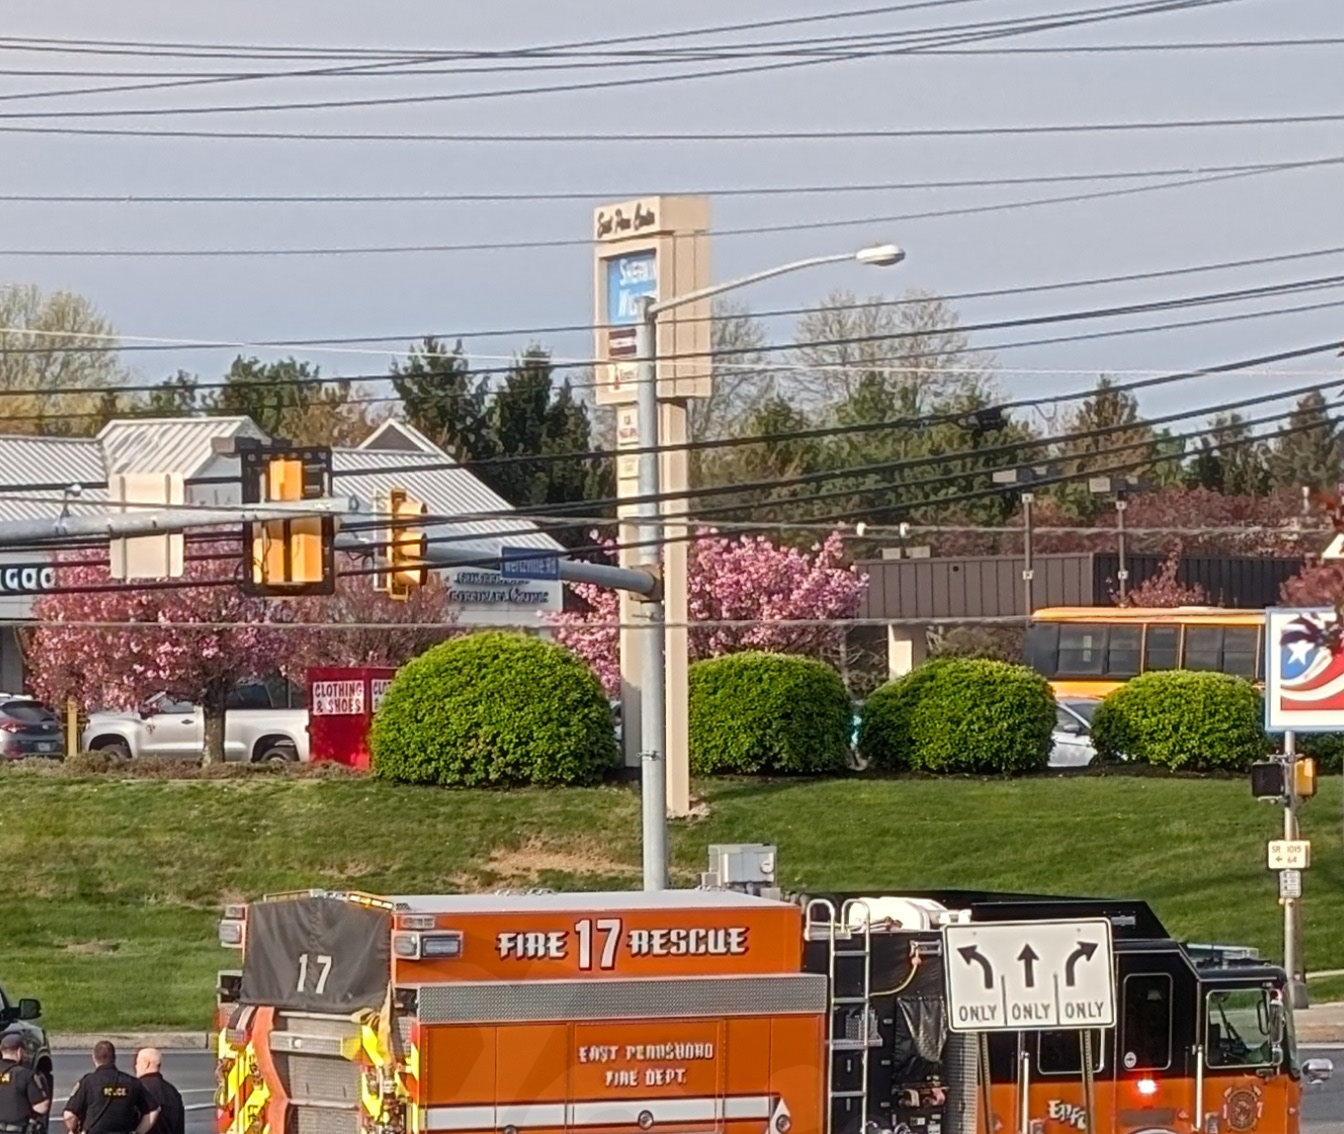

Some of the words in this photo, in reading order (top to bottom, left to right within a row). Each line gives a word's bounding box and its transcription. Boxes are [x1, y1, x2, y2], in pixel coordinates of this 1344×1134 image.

[314, 681, 362, 699] CLOTHING
[328, 698, 361, 714] SHOES
[496, 930, 569, 961] FIRE
[574, 917, 623, 971] 17
[626, 927, 752, 958] RESCUE
[297, 953, 332, 994] 17
[958, 1004, 997, 1023] ONLY
[1012, 1002, 1051, 1021] ONLY
[1065, 1001, 1104, 1019] ONLY
[578, 1045, 620, 1064] EAST
[625, 1041, 714, 1061] PENNSBORO
[605, 1069, 638, 1087] FIRE
